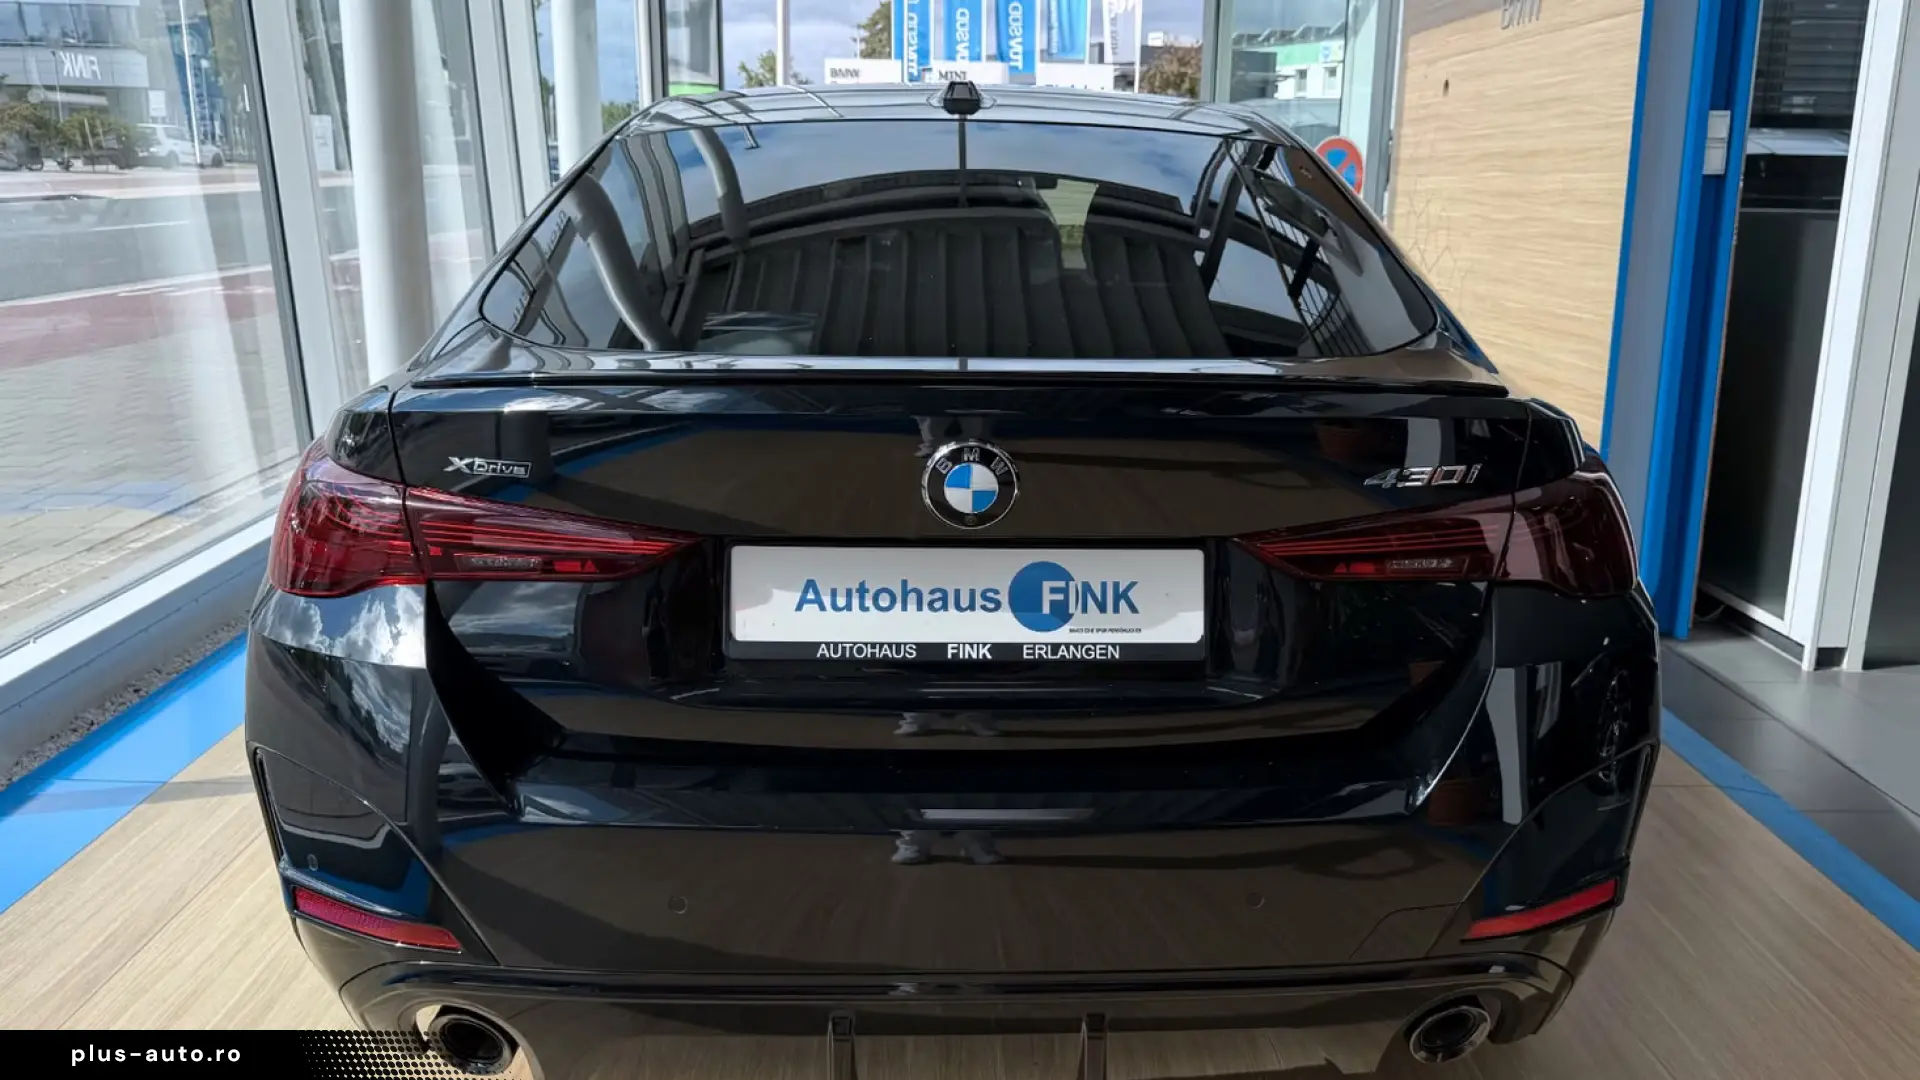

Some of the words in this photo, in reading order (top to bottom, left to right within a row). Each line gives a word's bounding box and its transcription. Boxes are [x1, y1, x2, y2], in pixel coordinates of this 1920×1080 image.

[830, 68, 860, 78] BMW
[935, 447, 1008, 475] BMW
[1363, 463, 1483, 488] 430i
[794, 578, 1003, 614] Autohaus
[1041, 580, 1140, 615] FINK
[816, 643, 917, 660] AUTOHAUS
[947, 643, 992, 660] FINK
[1023, 643, 1120, 660] ERLANGEN
